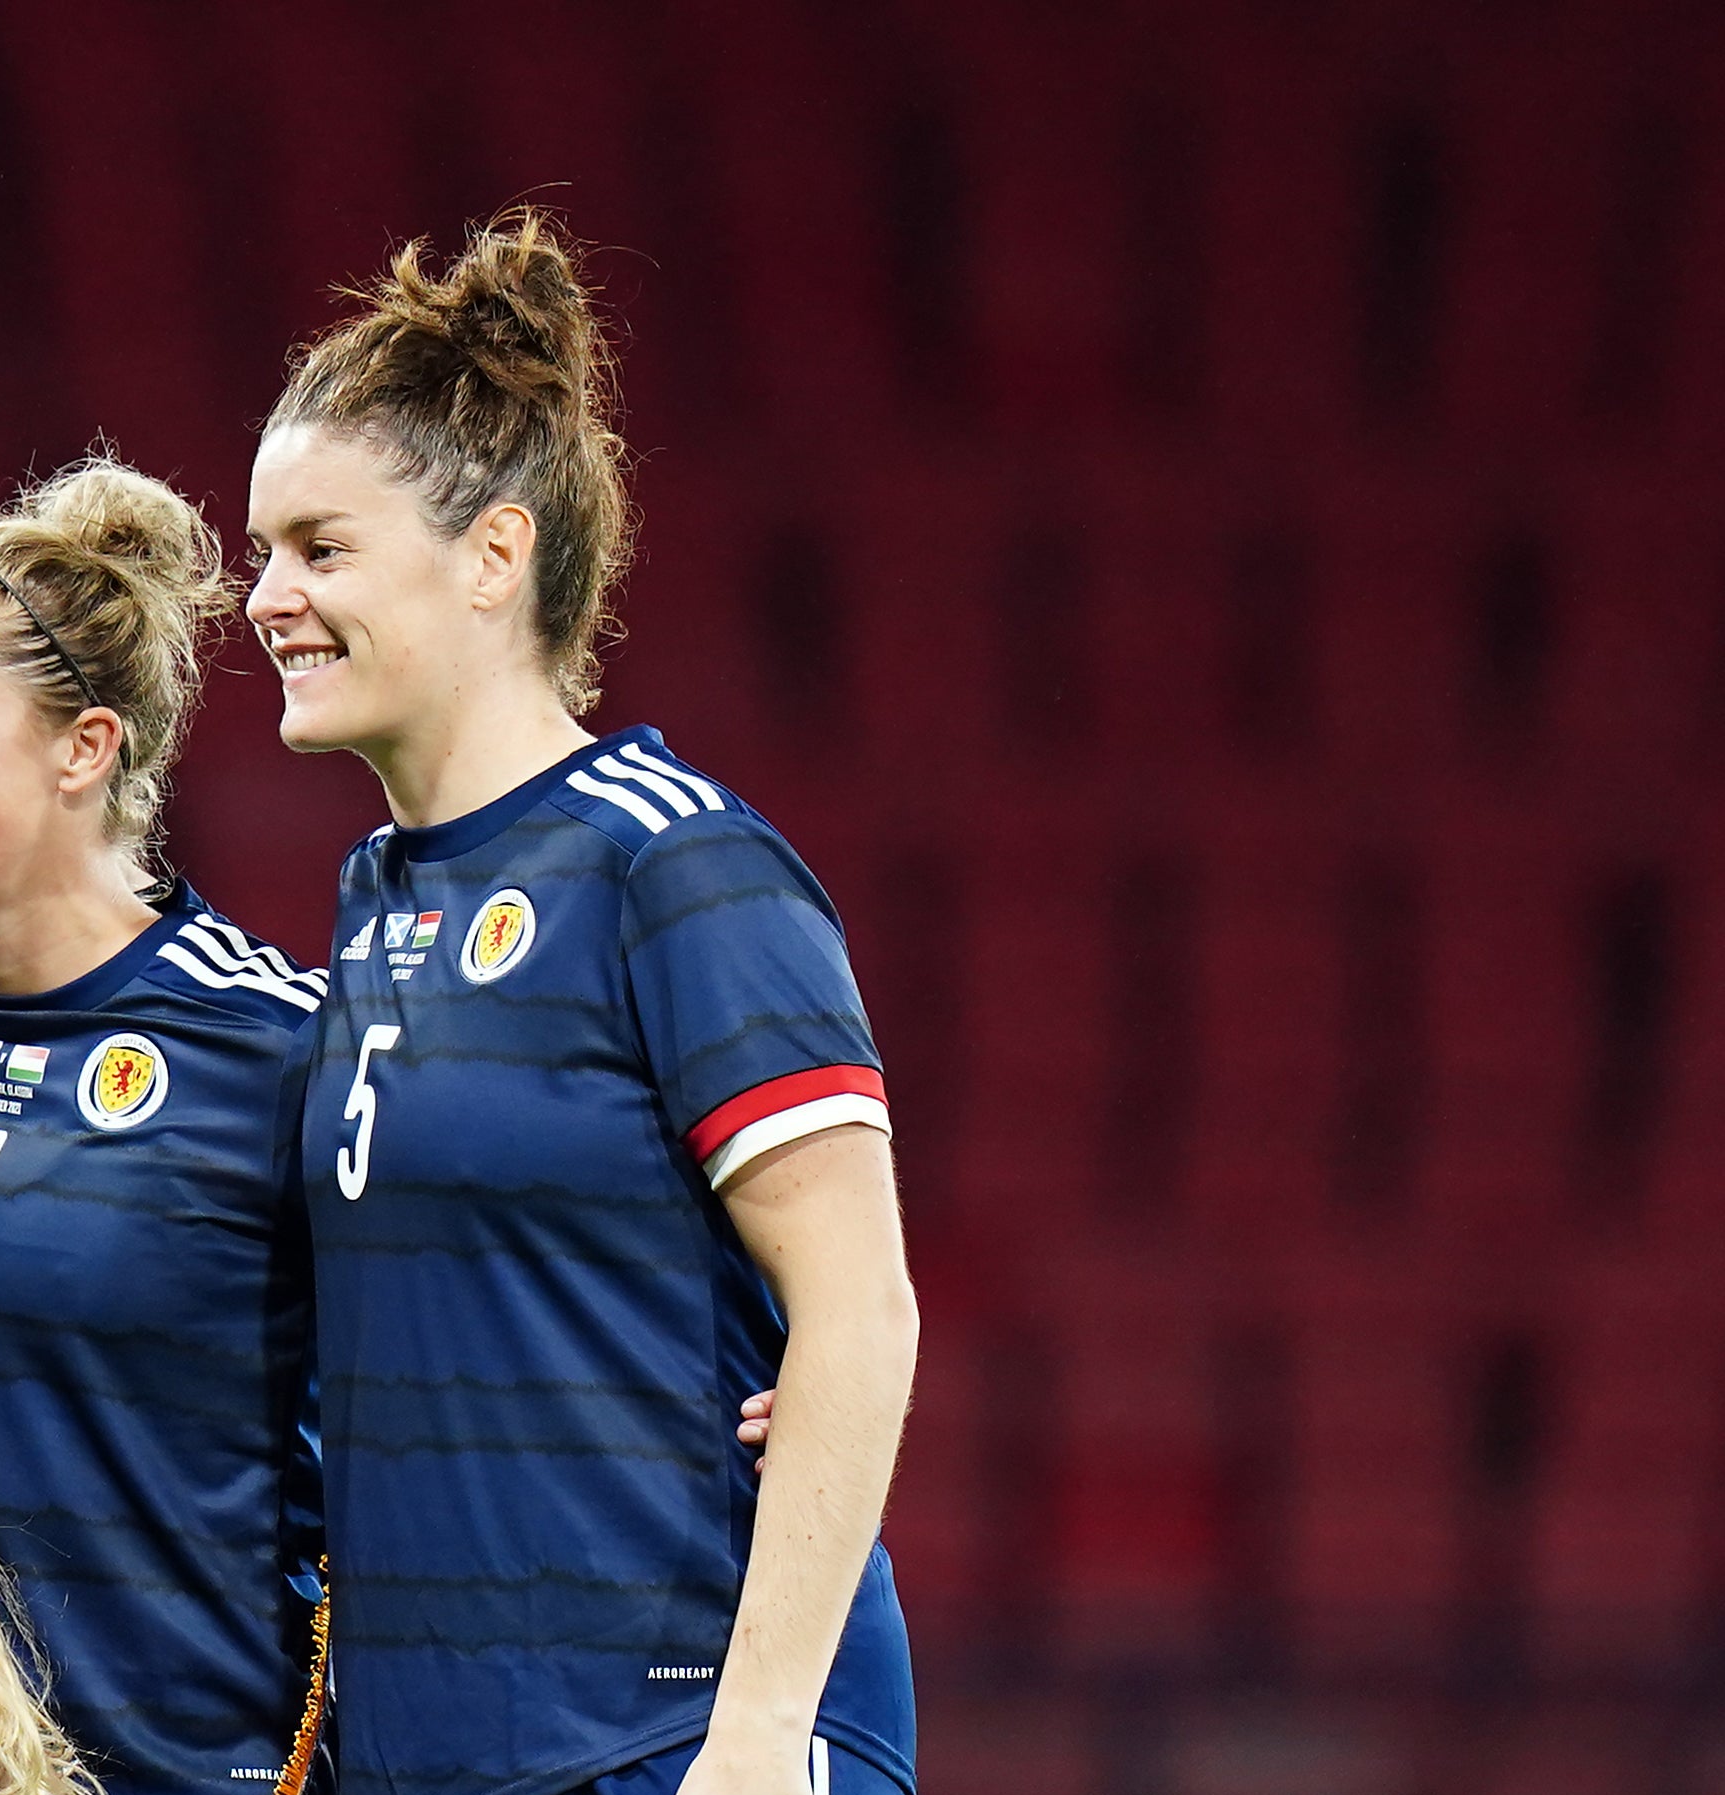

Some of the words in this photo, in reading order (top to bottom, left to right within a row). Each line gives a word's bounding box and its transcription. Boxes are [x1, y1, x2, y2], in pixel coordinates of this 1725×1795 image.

[336, 1024, 402, 1201] 5
[648, 1667, 714, 1679] AEROREADY
[230, 1768, 284, 1780] AEROREA
